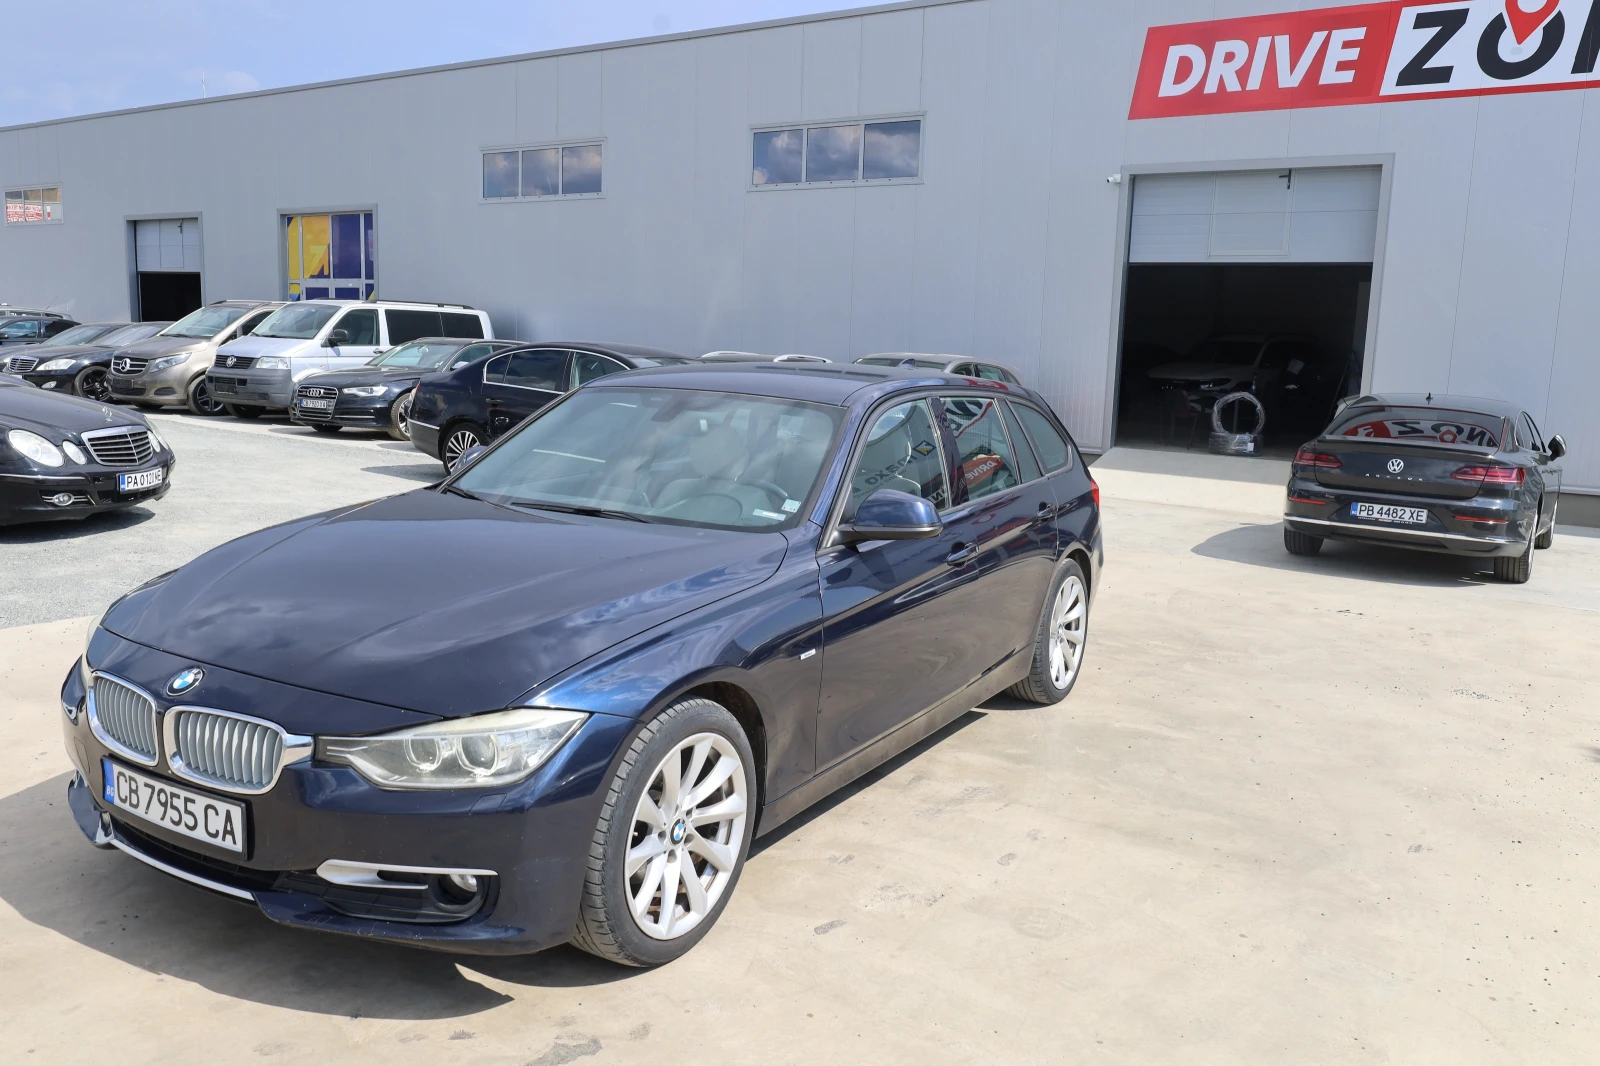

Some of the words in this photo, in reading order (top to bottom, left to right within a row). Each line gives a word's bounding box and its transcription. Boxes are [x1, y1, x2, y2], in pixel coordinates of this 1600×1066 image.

[1158, 27, 1367, 97] DRIVE
[126, 475, 138, 488] PA
[1359, 504, 1374, 516] PB
[1377, 506, 1406, 520] 4482
[1408, 509, 1425, 522] XE
[106, 785, 114, 797] BG
[116, 770, 140, 809] CB
[143, 781, 198, 831] 7955
[204, 803, 237, 846] CA
